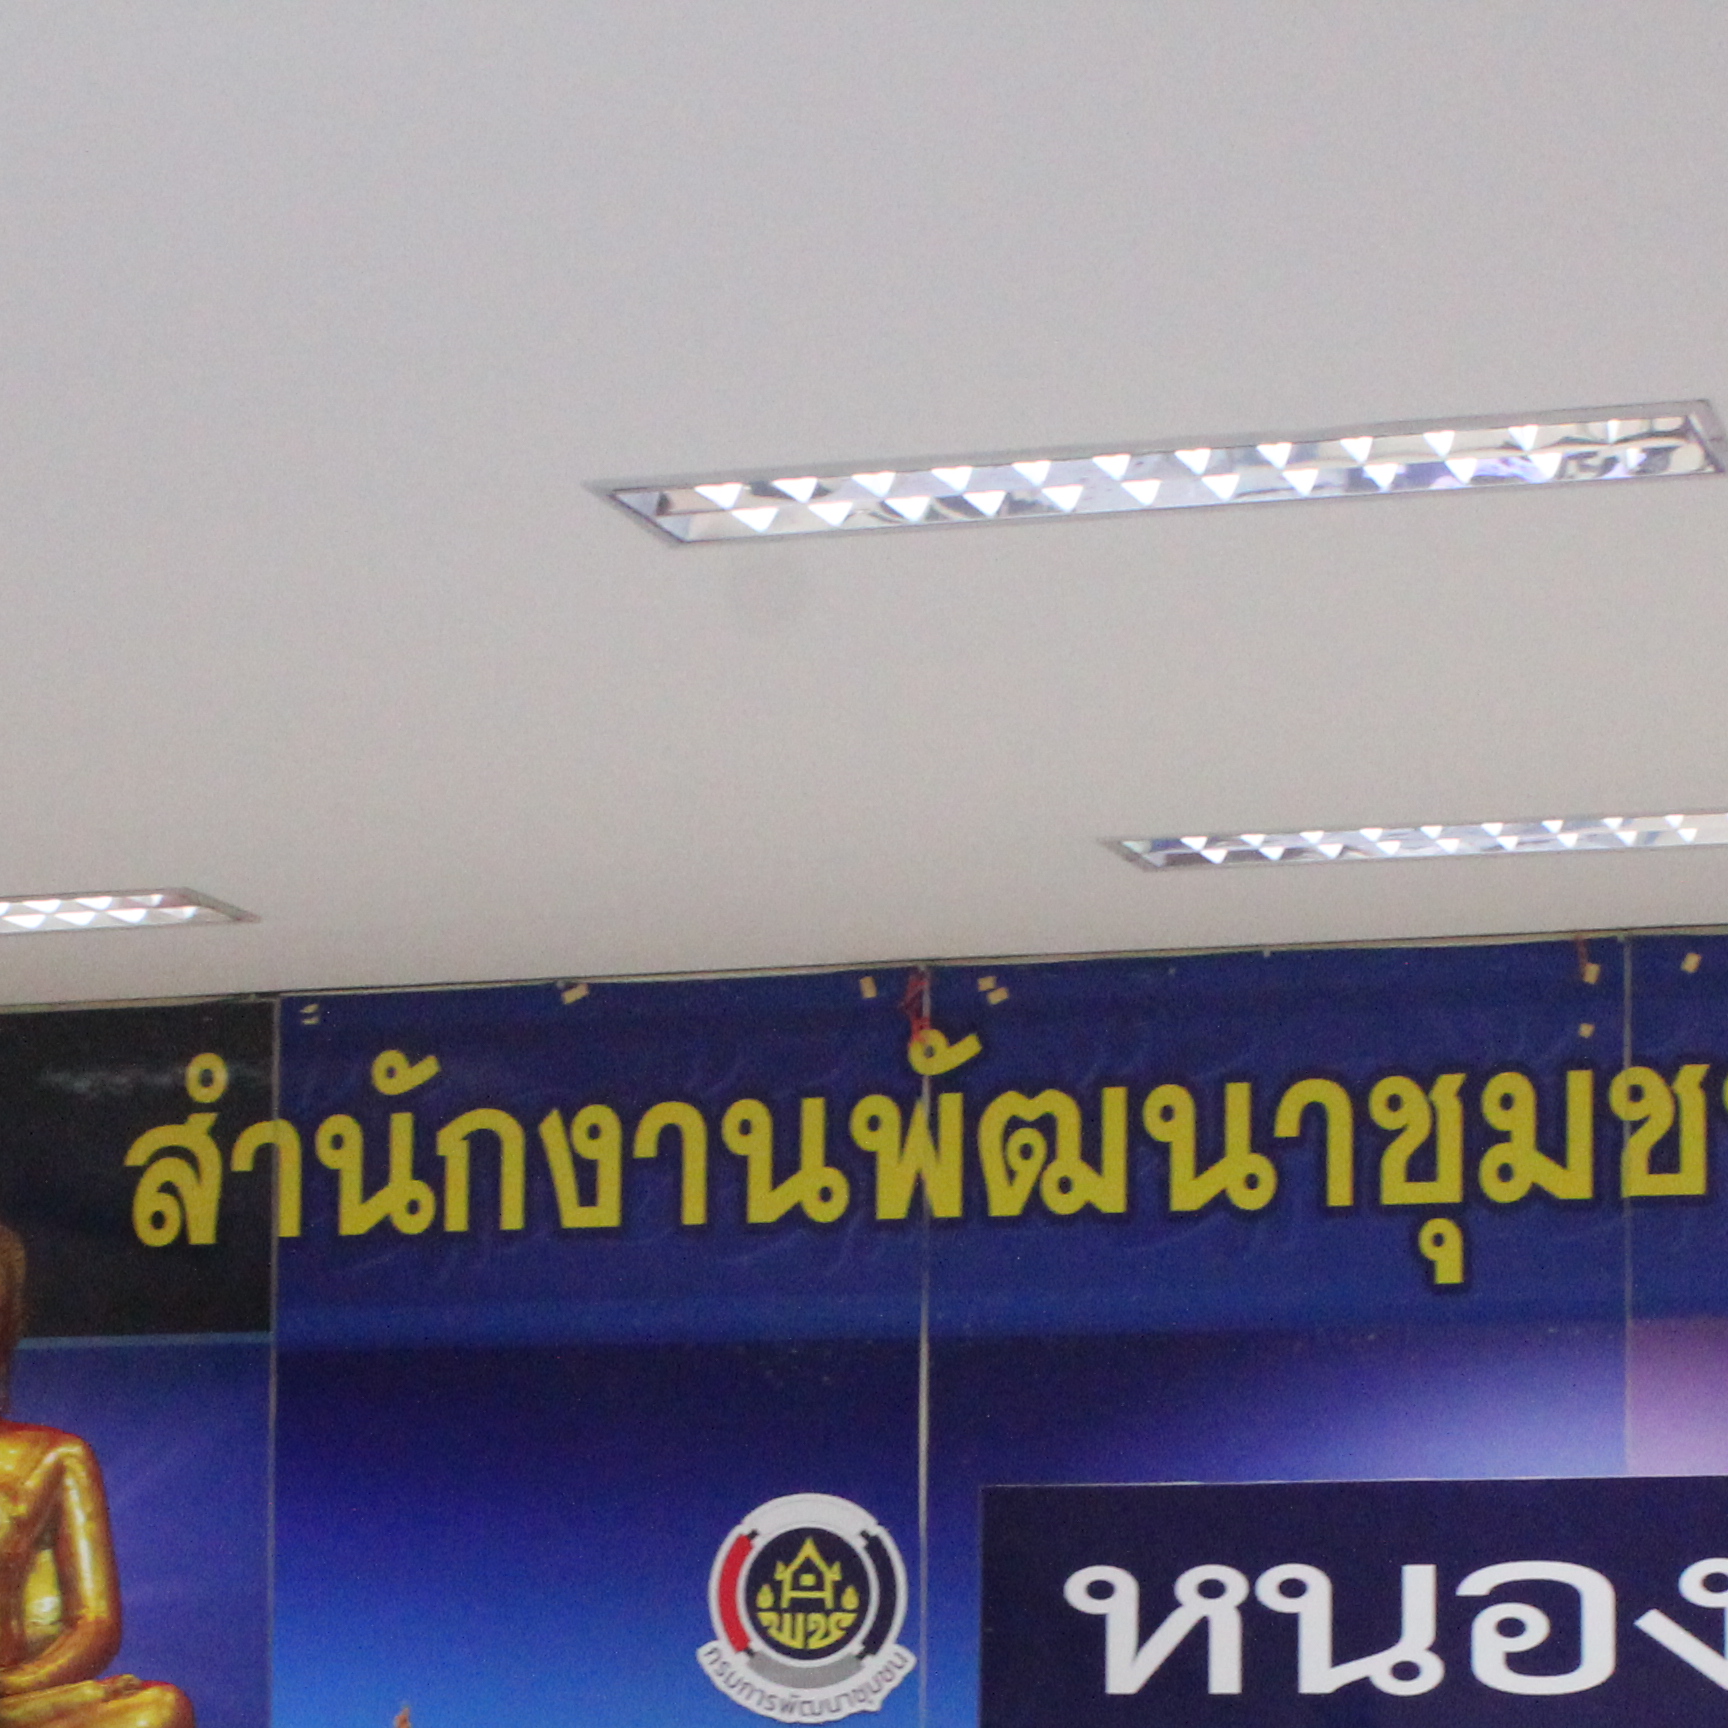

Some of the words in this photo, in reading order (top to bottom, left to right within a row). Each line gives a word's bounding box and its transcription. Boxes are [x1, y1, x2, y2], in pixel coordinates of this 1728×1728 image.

[703, 1646, 910, 1717] กรมการพัฒนาชุมชน
